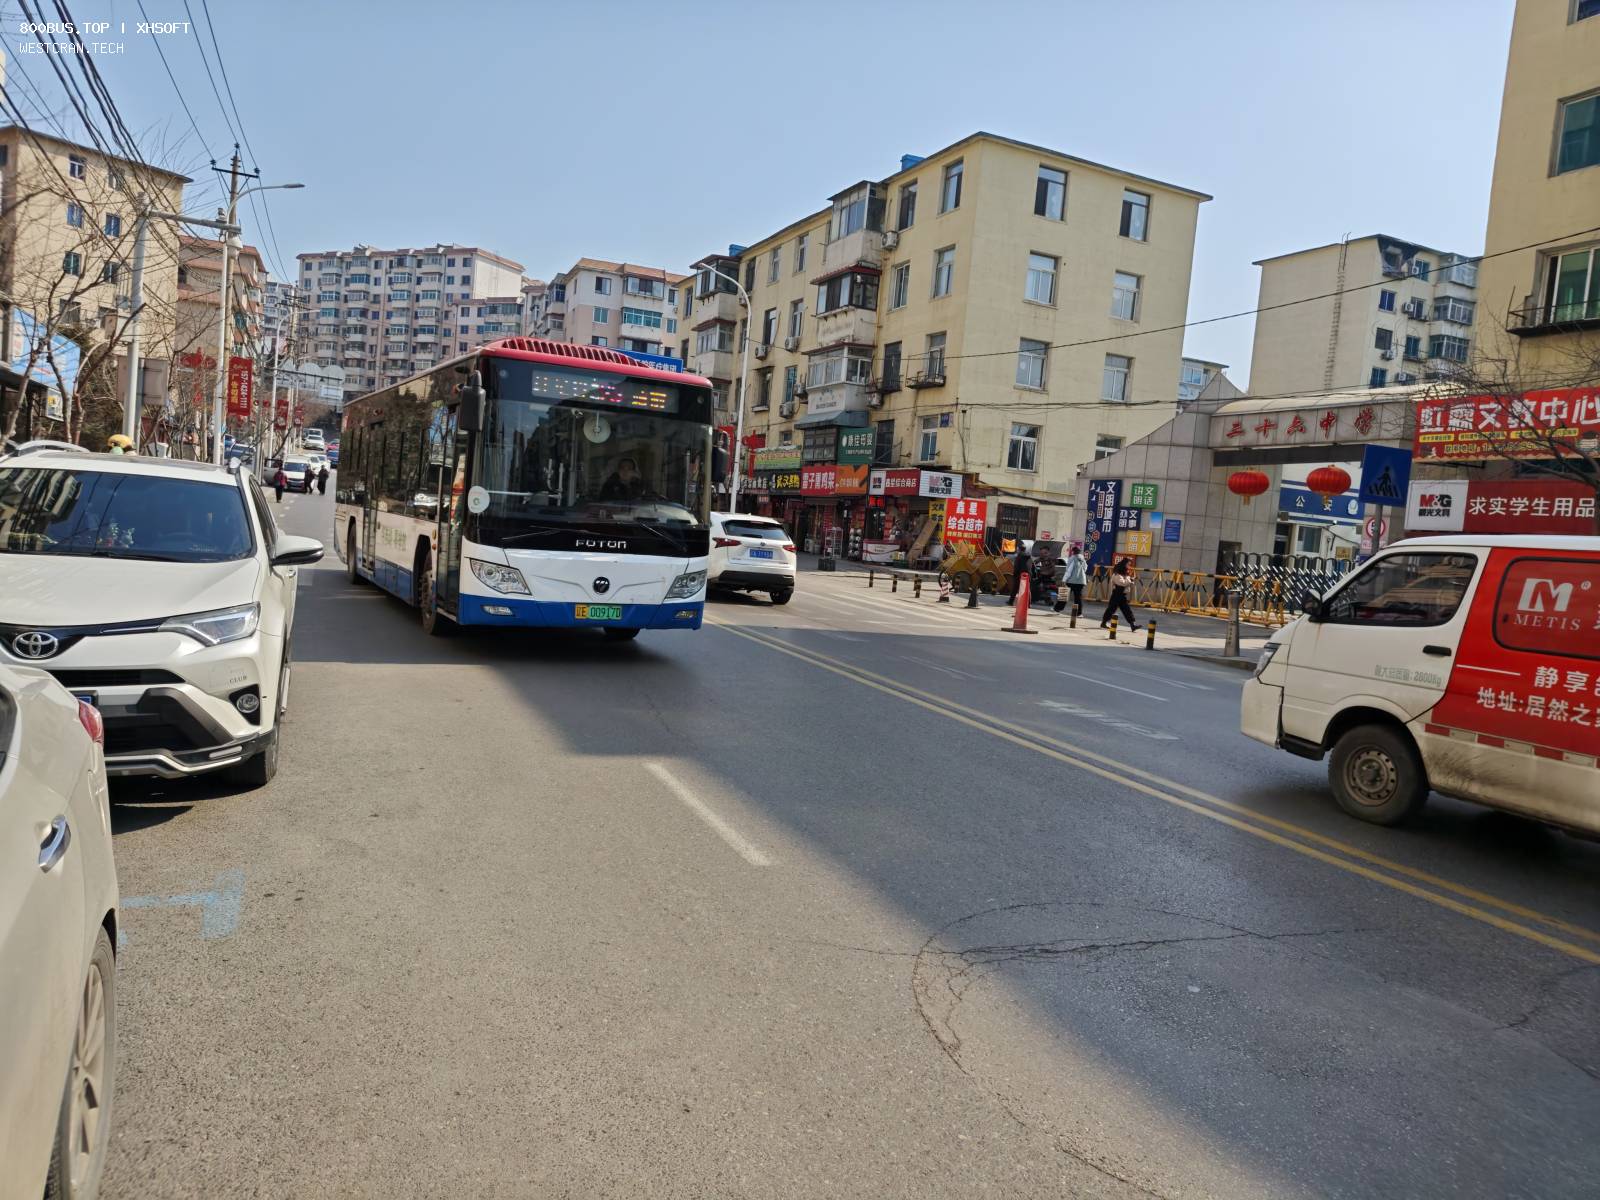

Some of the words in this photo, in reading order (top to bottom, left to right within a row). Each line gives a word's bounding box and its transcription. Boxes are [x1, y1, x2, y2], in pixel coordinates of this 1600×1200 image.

[1102, 481, 1116, 533] 文明城市
[1420, 494, 1451, 507] M&G
[1468, 497, 1596, 518] 求实学生用品
[576, 539, 627, 549] FOTON
[1513, 613, 1582, 631] METIS
